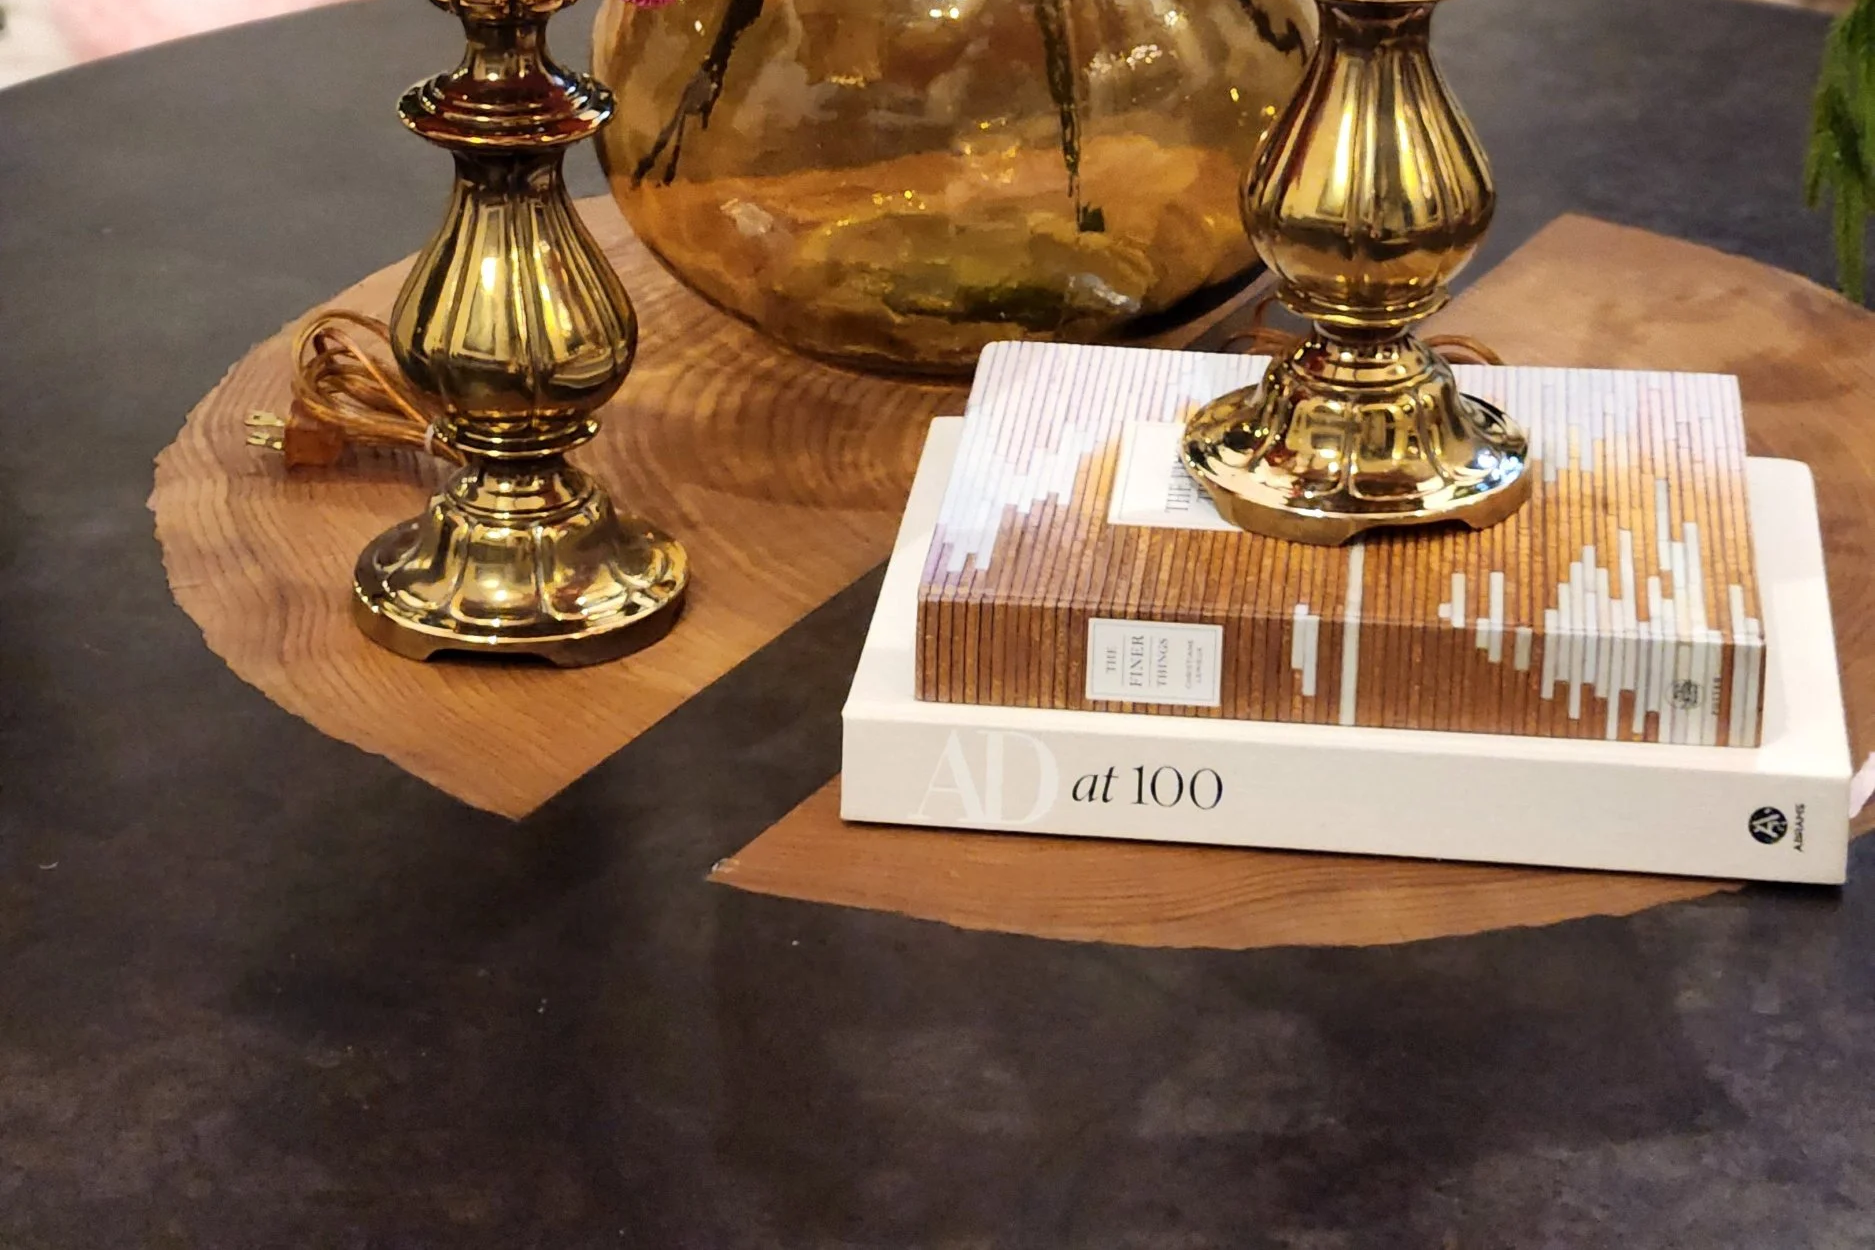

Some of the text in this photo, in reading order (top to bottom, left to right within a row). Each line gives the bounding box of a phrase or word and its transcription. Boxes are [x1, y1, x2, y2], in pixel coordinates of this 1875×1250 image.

[1164, 482, 1192, 512] THE
[1105, 646, 1117, 674] THE
[1129, 634, 1145, 687] FINER
[1157, 637, 1169, 687] THINGS
[906, 729, 1224, 825] AD at 100
